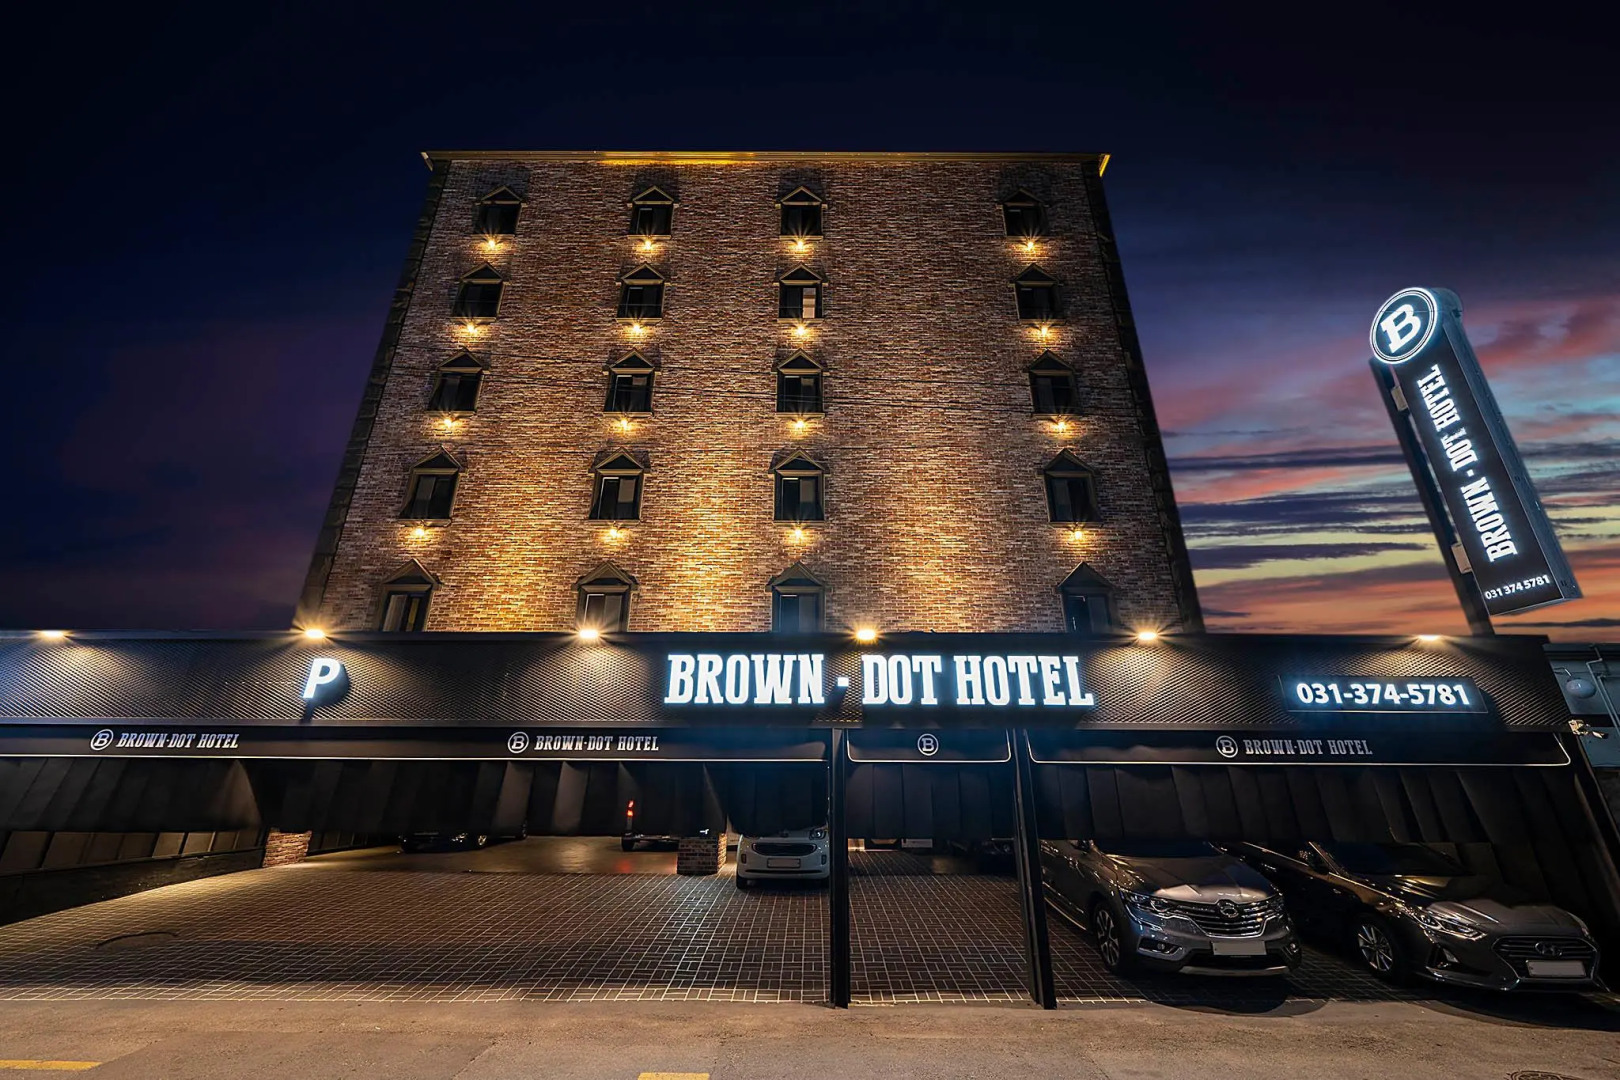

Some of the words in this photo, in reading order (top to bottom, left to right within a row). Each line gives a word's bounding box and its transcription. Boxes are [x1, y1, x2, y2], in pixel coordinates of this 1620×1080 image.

[1380, 304, 1421, 354] B
[1416, 364, 1460, 432] HOTEL
[1440, 427, 1478, 472] DOT
[1460, 476, 1518, 562] BROWN
[1484, 588, 1503, 600] 031
[1503, 581, 1524, 595] 374
[1523, 574, 1551, 590] 5781
[303, 658, 340, 699] P
[664, 653, 825, 705] BROWN
[861, 654, 942, 705] DOT
[953, 655, 1095, 706] HOTEL
[1296, 682, 1471, 706] 031-374-5781
[197, 733, 240, 749] HOTEL
[617, 736, 659, 751] HOTEL
[1327, 739, 1373, 755] HOTEL
